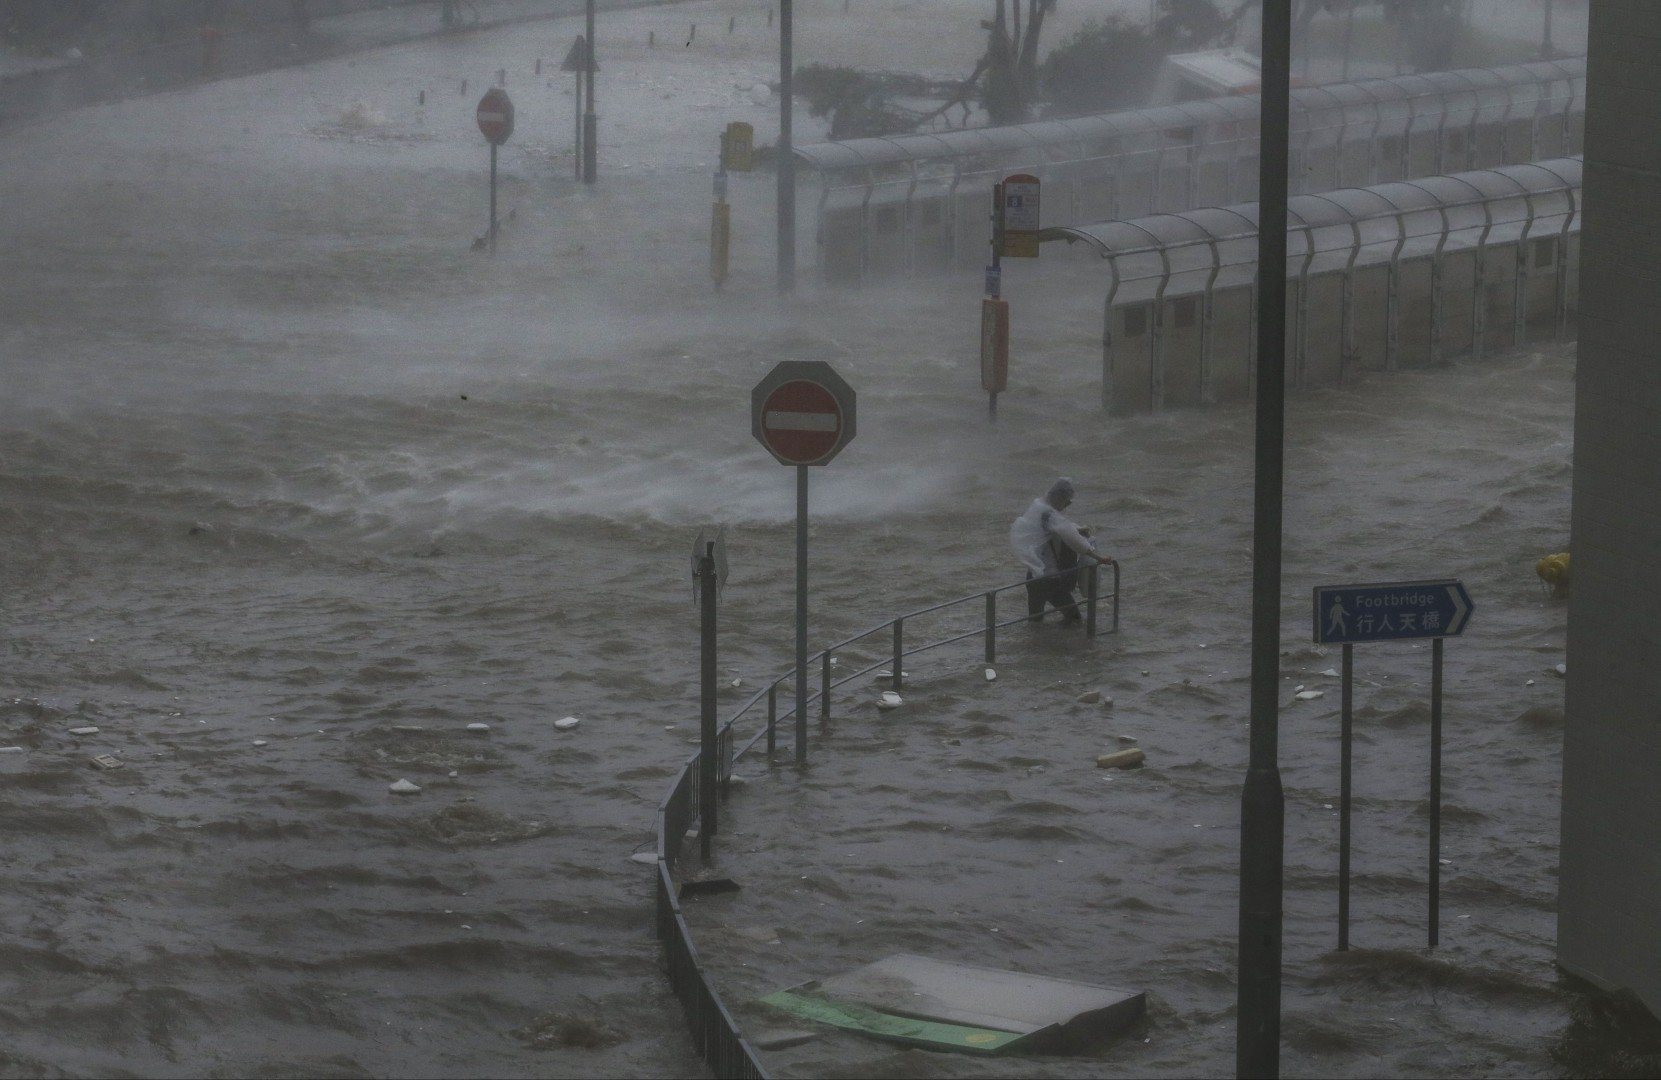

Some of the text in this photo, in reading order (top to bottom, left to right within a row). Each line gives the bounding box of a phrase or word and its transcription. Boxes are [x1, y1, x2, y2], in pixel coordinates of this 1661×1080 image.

[1356, 592, 1435, 607] Footbridge
[1357, 611, 1440, 633] 行人天橋
